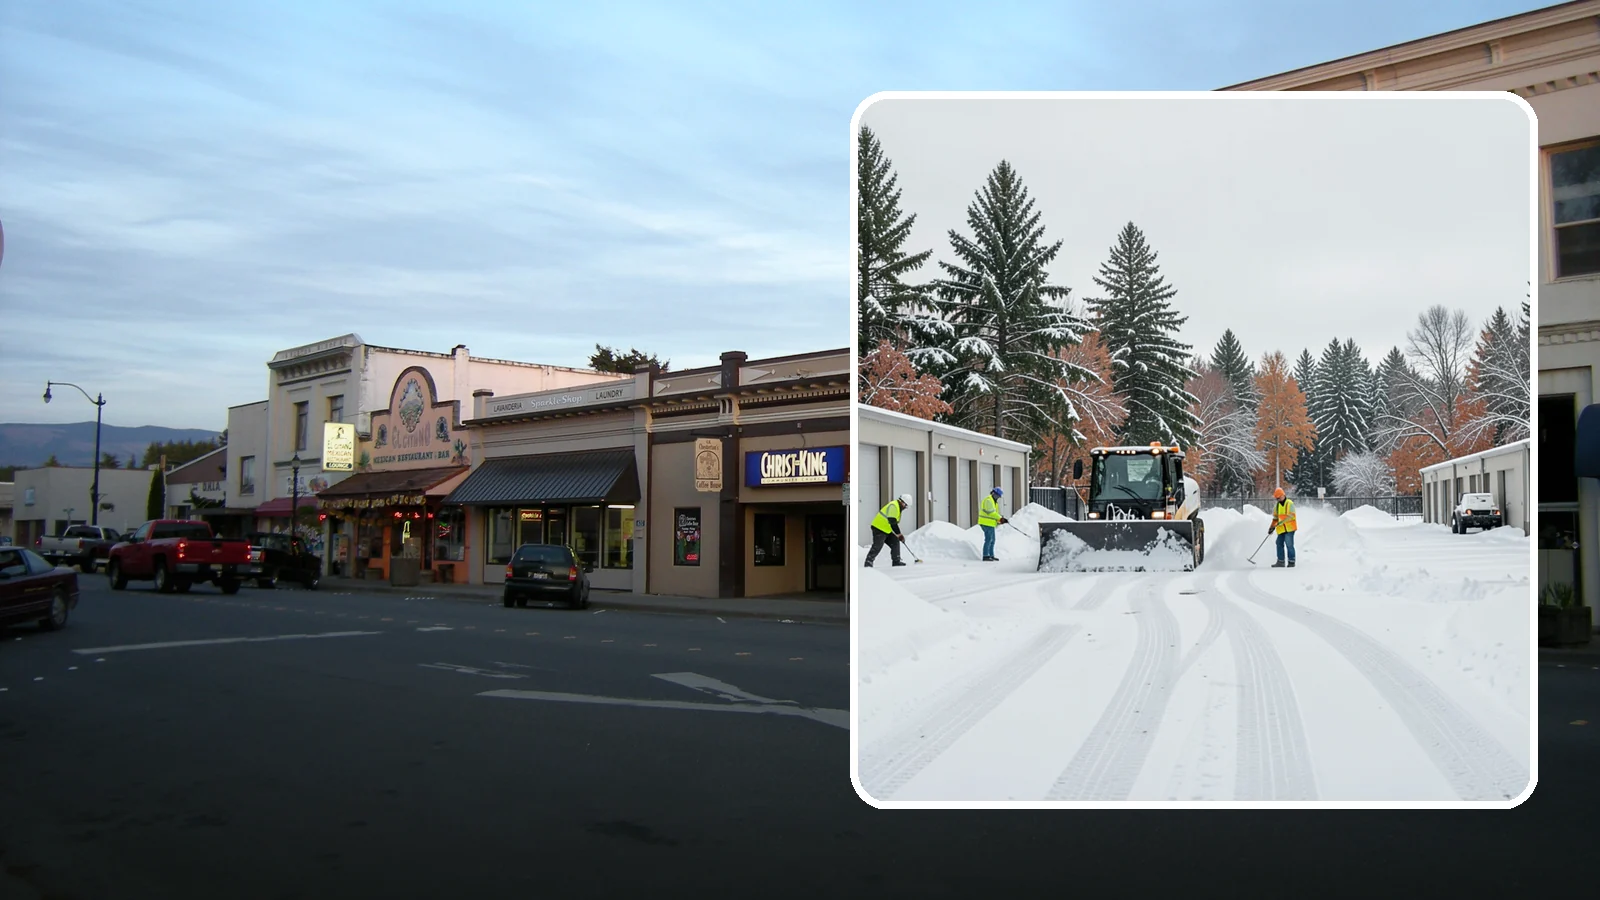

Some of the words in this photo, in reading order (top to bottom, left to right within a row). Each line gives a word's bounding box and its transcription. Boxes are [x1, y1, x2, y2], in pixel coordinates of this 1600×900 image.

[595, 388, 623, 400] LAUNDRY
[494, 402, 522, 412] LAVANDERIA
[531, 395, 560, 409] Sparkle
[562, 394, 582, 405] Shop
[398, 451, 433, 462] RESTAURANT
[438, 450, 450, 459] BAR
[761, 452, 797, 478] CHRIST
[799, 450, 827, 476] KING
